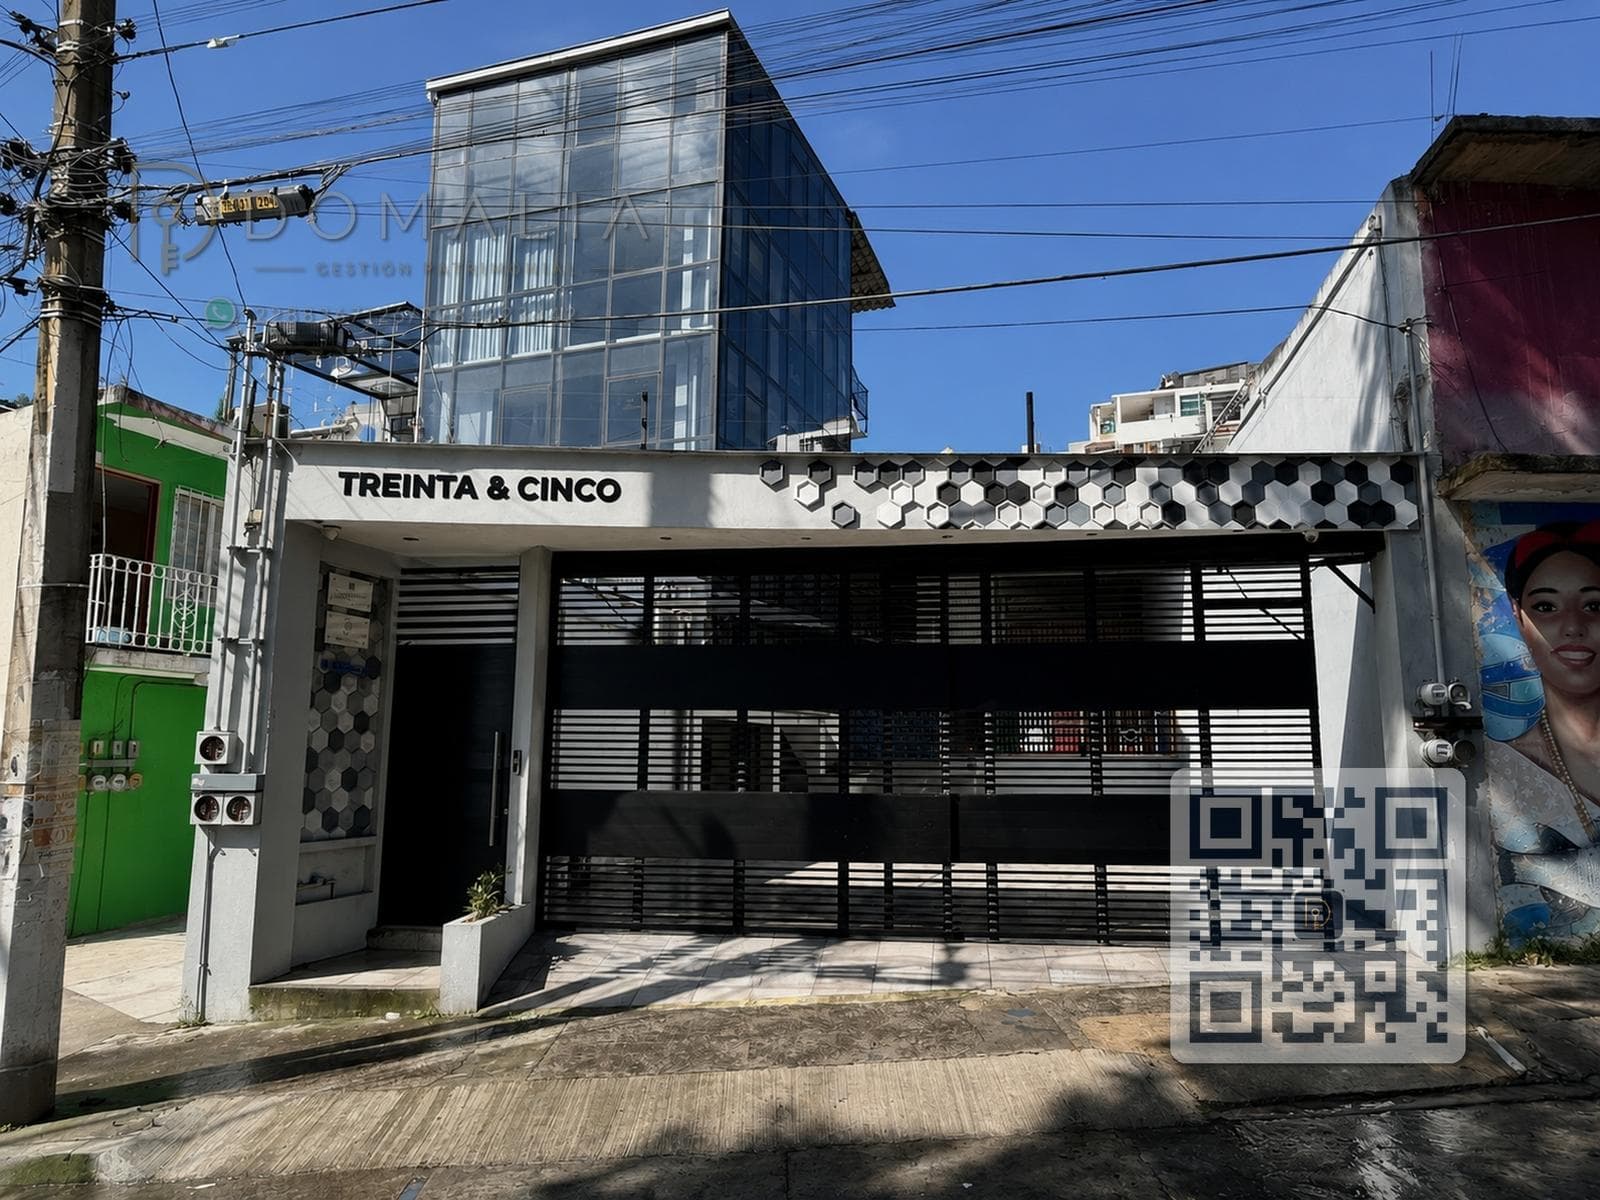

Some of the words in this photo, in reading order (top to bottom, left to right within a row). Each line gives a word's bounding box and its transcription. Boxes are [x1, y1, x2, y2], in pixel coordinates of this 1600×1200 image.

[338, 471, 479, 500] TREINTA
[486, 475, 510, 501] &
[517, 476, 622, 503] CINCO
